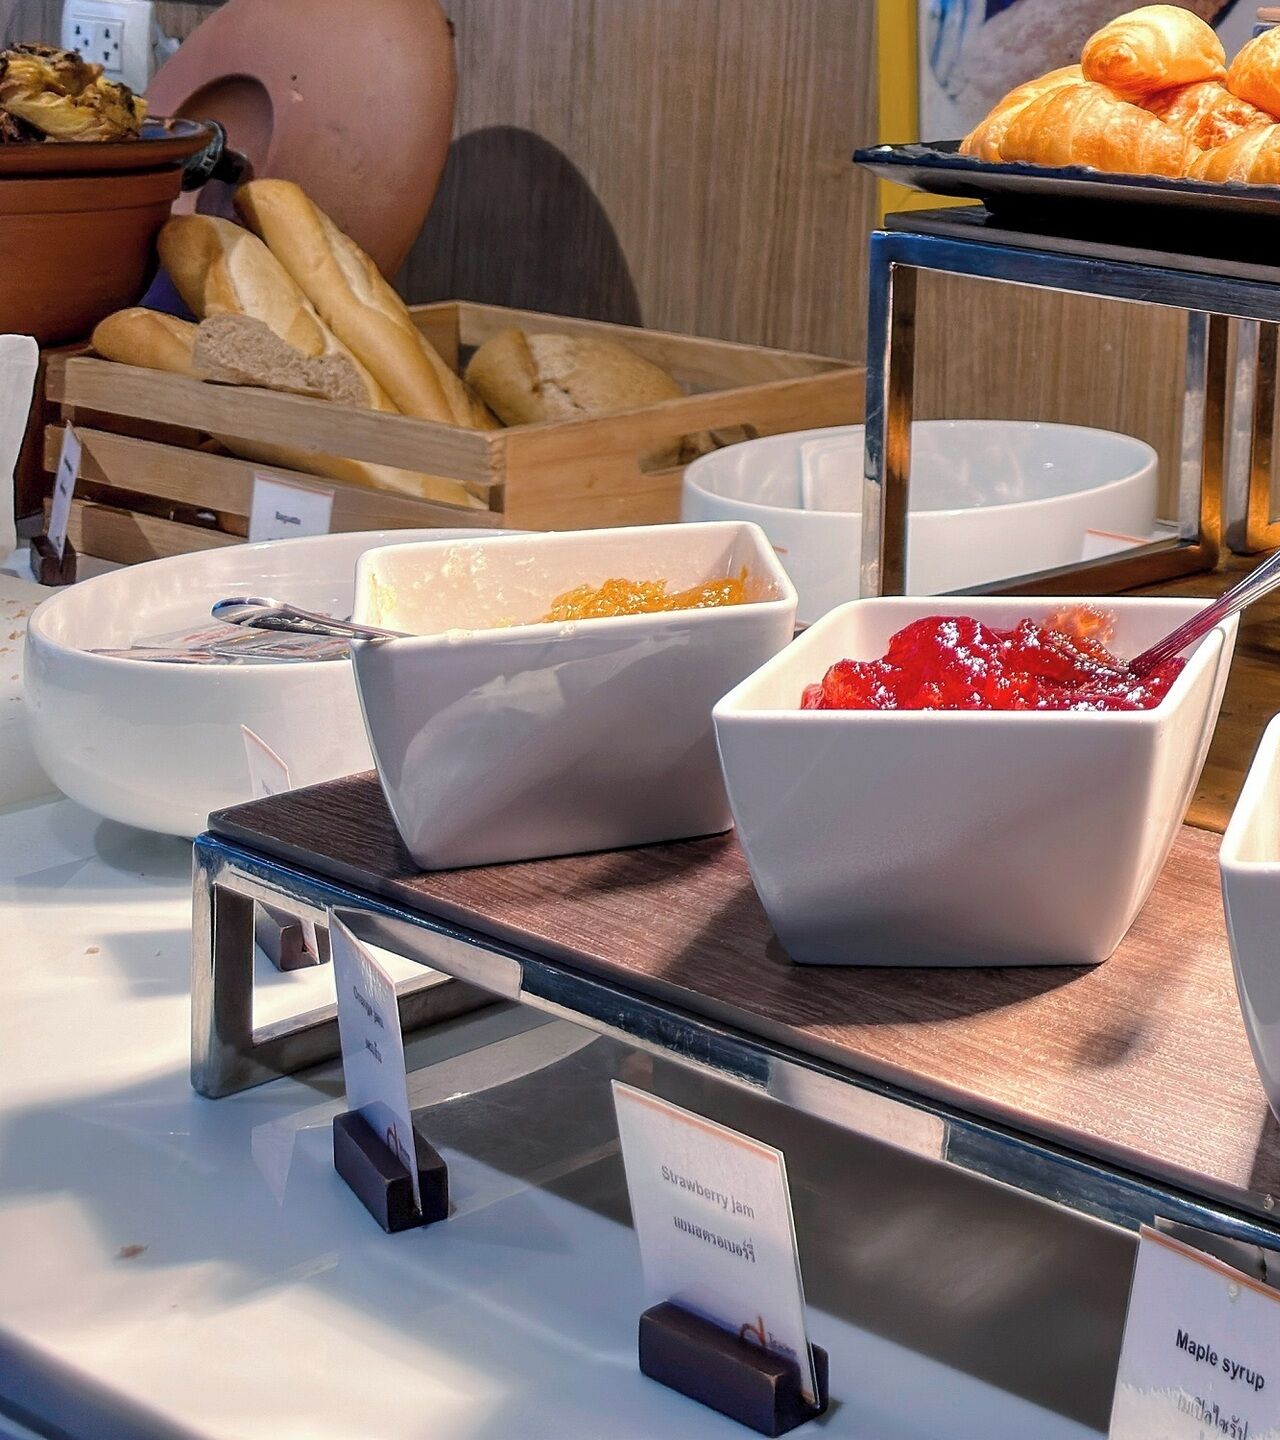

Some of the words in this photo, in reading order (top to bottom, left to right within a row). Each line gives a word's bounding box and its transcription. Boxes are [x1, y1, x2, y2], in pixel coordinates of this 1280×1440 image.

[661, 1165, 728, 1209] Strawberry
[731, 1196, 755, 1220] jam
[1176, 1328, 1218, 1366] Maple
[1222, 1358, 1265, 1392] syrup
